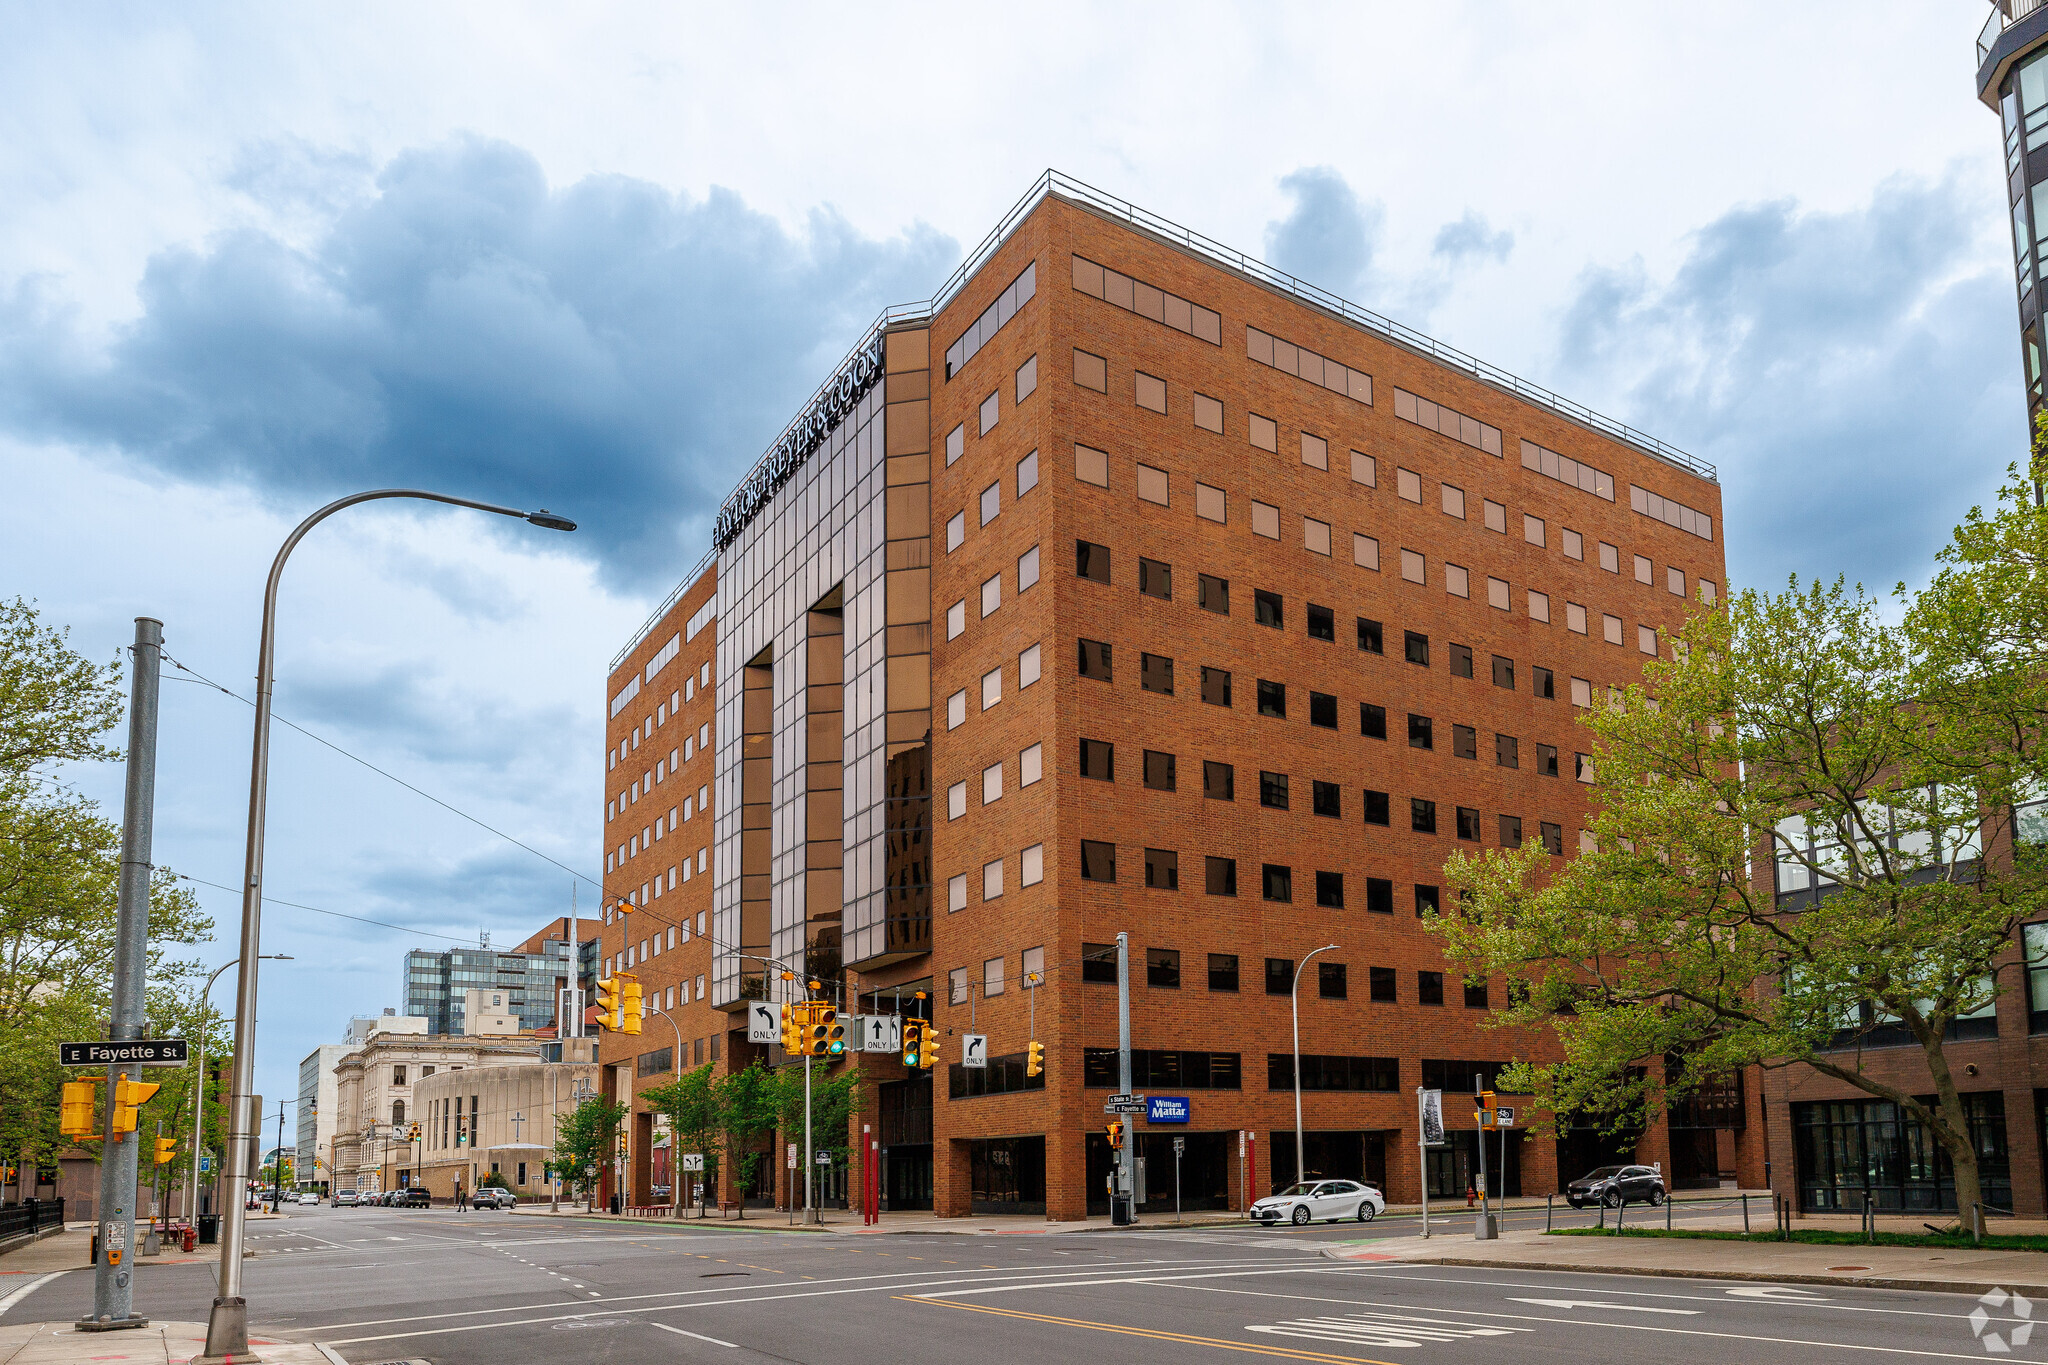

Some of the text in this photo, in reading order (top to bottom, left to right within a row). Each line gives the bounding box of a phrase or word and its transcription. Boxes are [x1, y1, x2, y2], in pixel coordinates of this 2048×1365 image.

[761, 417, 815, 492] FREYER
[830, 338, 883, 413] COON
[753, 1031, 777, 1039] ONLY
[71, 1046, 178, 1063] E Fayette St
[1155, 1099, 1182, 1107] William
[1121, 1105, 1139, 1113] Fayette
